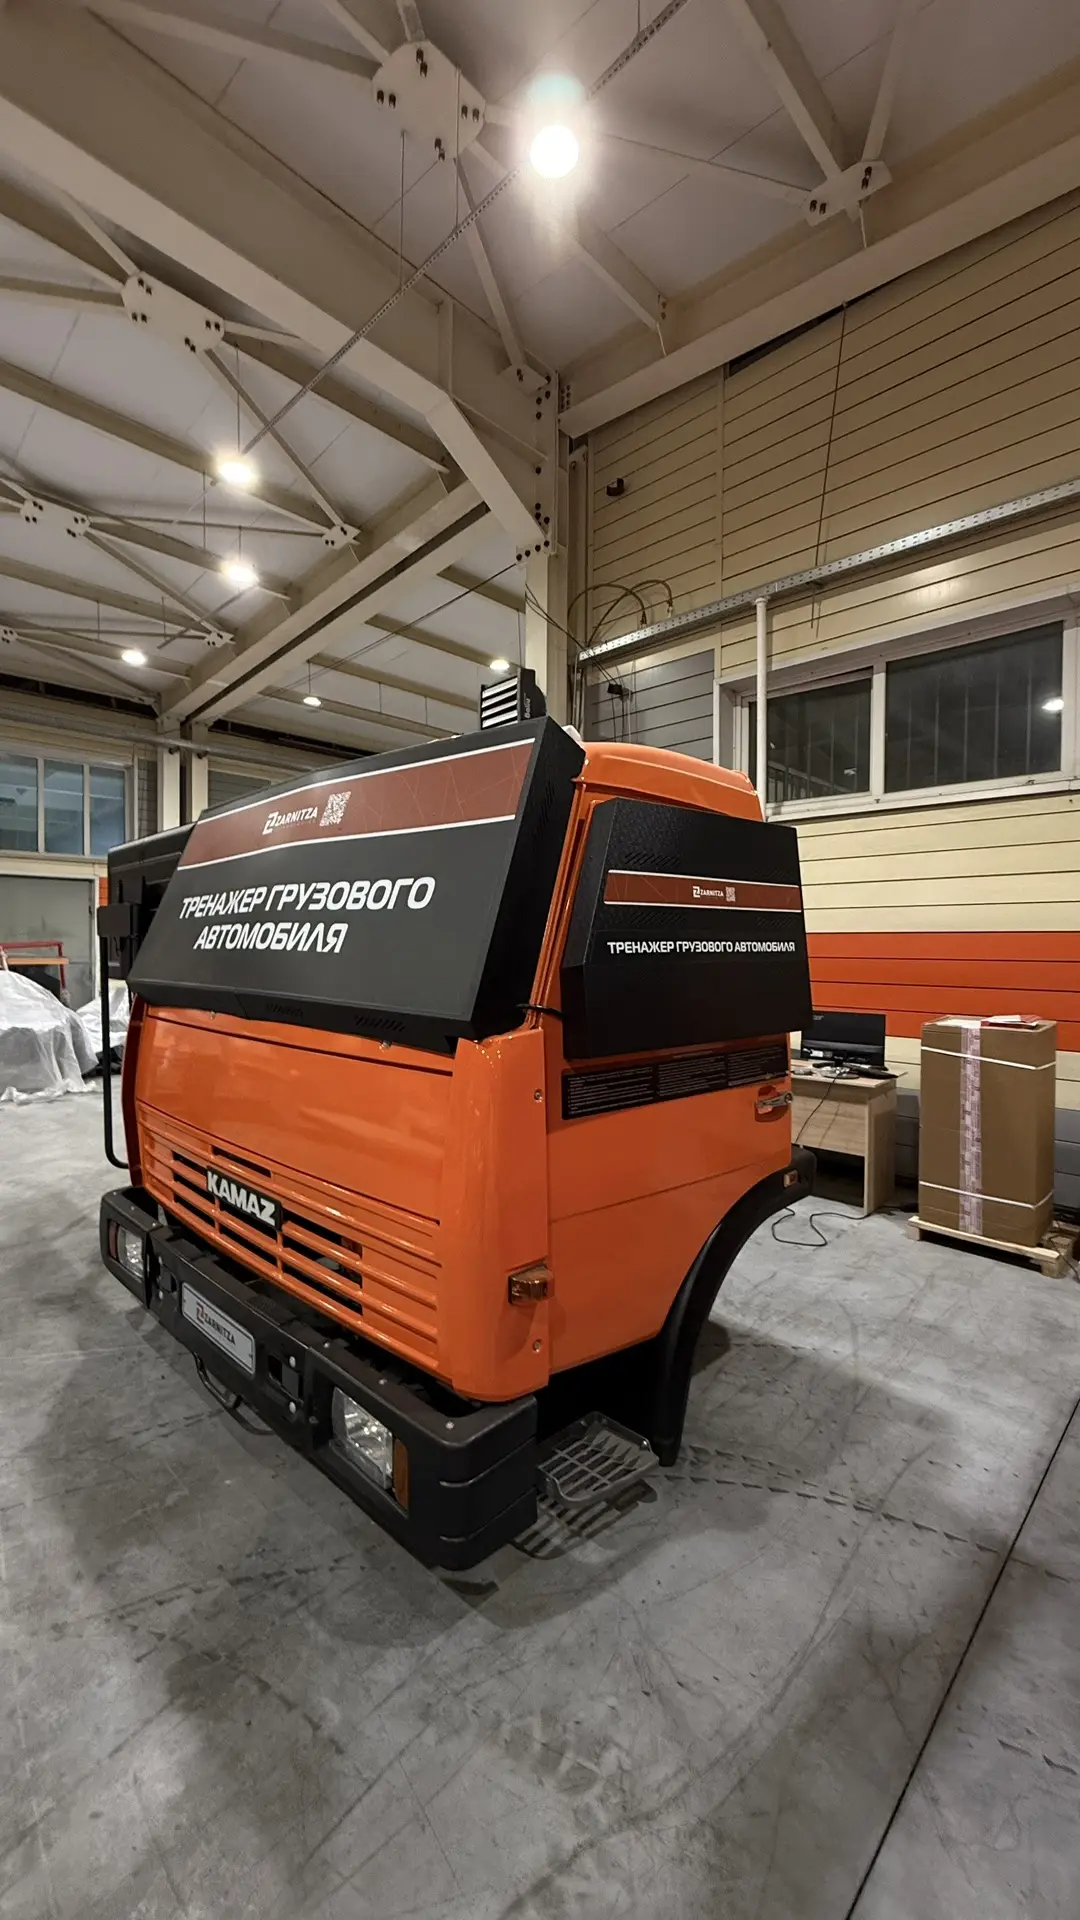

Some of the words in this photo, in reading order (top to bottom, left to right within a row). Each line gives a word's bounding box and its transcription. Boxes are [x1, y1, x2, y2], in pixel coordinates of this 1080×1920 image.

[275, 807, 319, 827] ZARNITZA
[179, 886, 267, 919] ТРЕНАЖЕР
[265, 876, 436, 911] ГРУЗОВОГО
[193, 922, 349, 953] АВТОМОБИЛЯ
[607, 941, 674, 954] ТРЕНАЖЕР
[676, 941, 733, 953] ГРУЗОВОГО
[734, 941, 796, 952] АВТОМОБИЛЯ
[207, 1171, 275, 1227] KAMAZ
